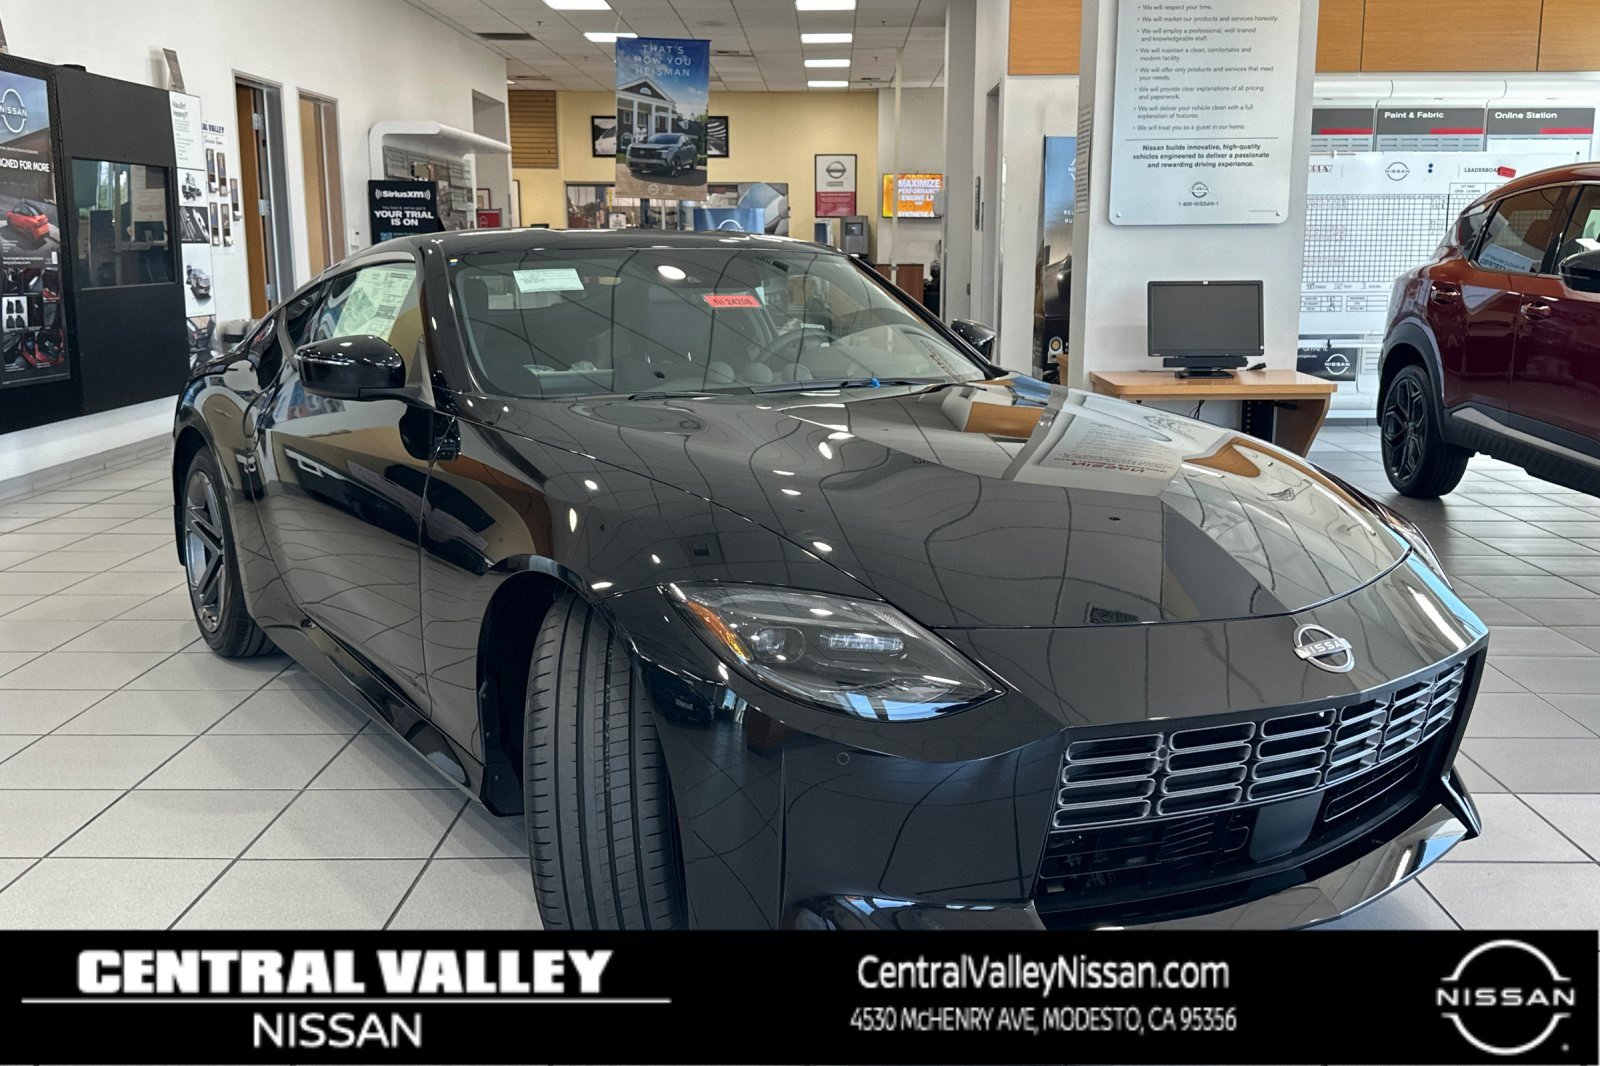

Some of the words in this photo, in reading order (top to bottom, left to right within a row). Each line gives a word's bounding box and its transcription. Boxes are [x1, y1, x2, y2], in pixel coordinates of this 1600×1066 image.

[642, 44, 683, 55] THAT'S
[634, 55, 661, 65] HOW
[667, 57, 691, 66] YOU
[635, 67, 690, 77] HEISMAN
[0, 105, 27, 117] NISSAN
[1417, 111, 1445, 119] Fabric
[1494, 112, 1524, 120] Online
[1526, 112, 1558, 120] Station
[19, 160, 33, 170] FOR
[33, 162, 50, 172] MORE
[898, 179, 941, 188] MAXIMIZE
[374, 210, 402, 218] YOUR
[404, 211, 434, 219] TRIAL
